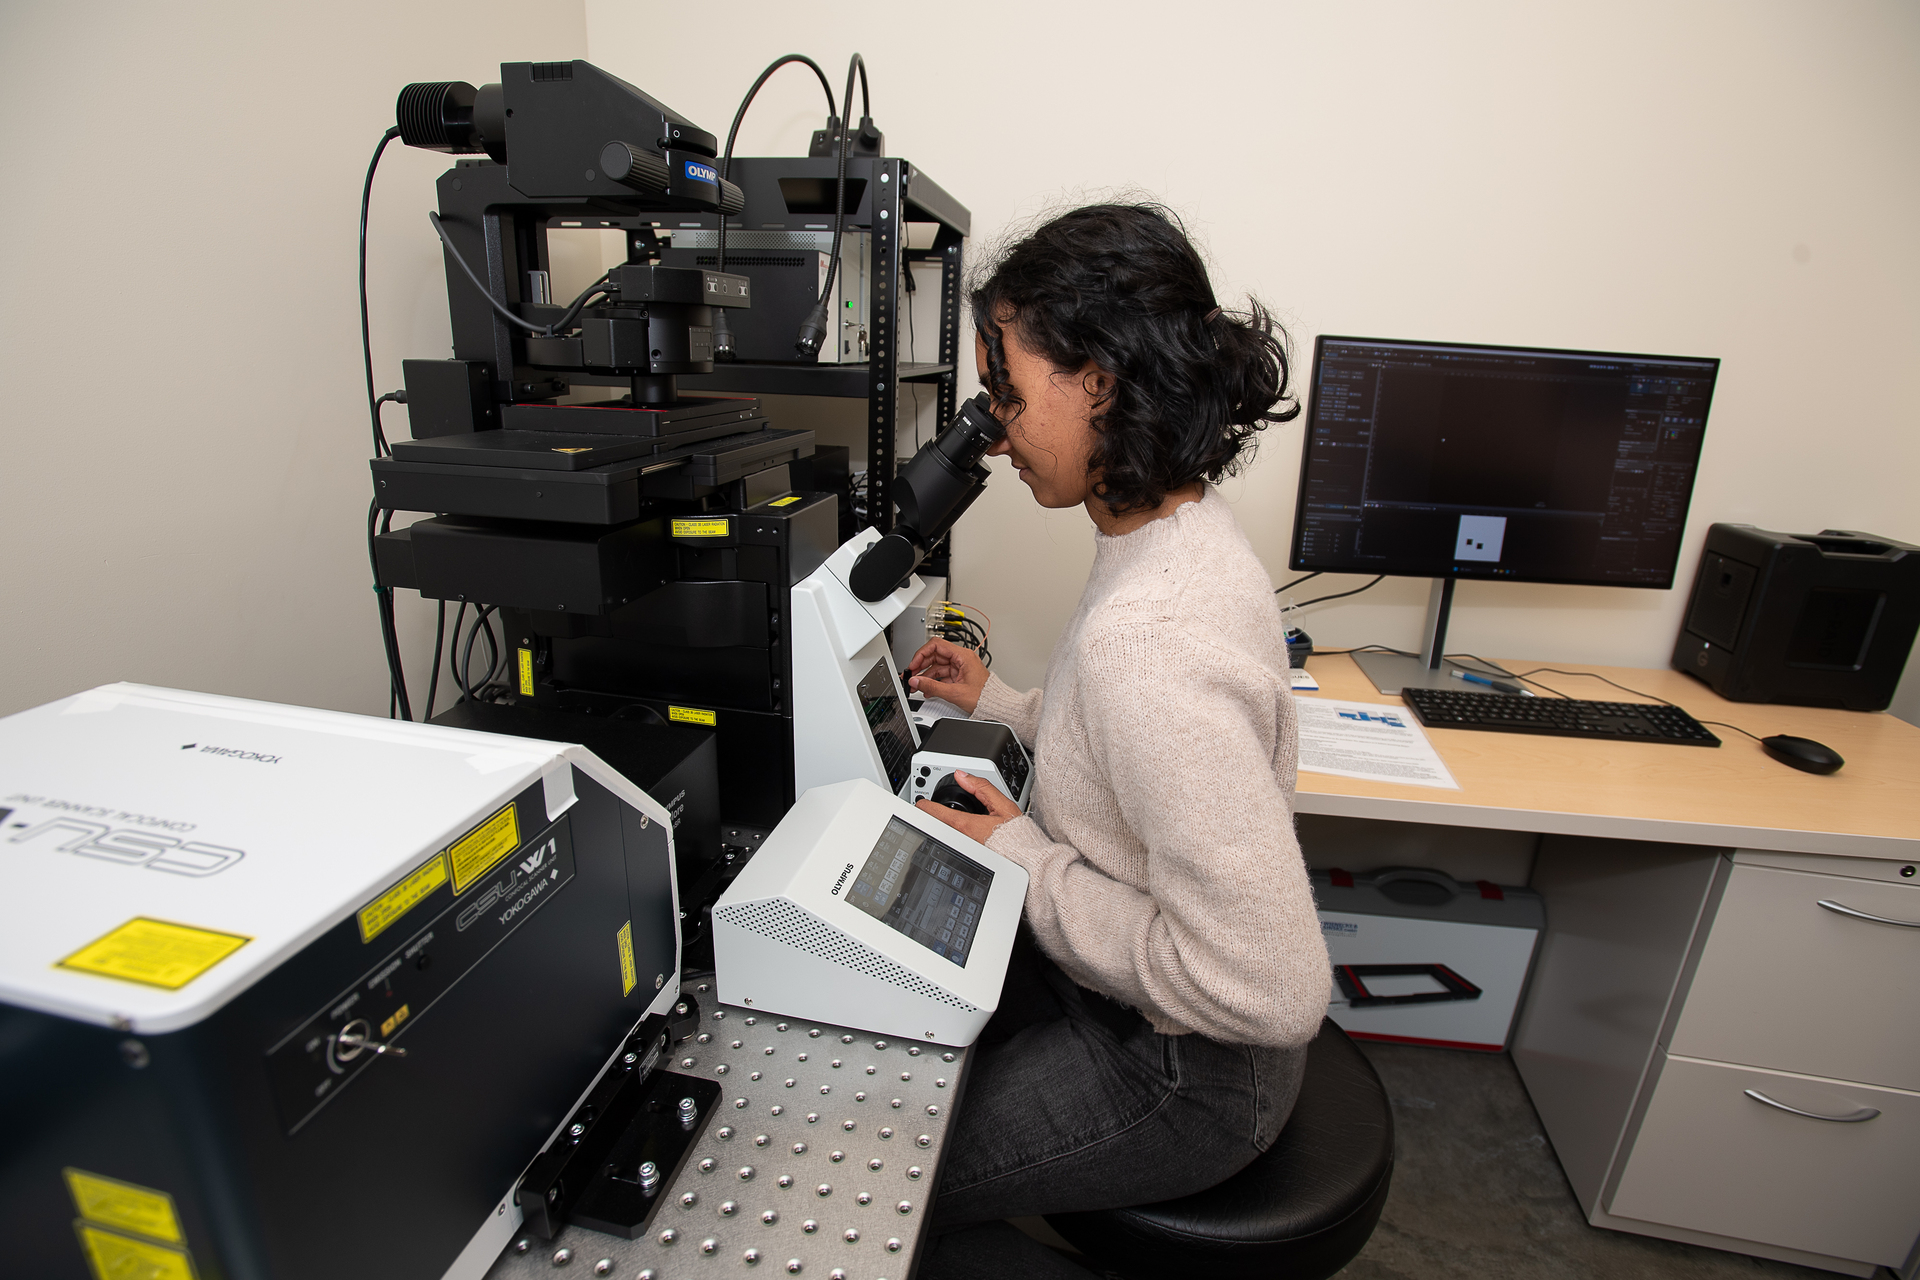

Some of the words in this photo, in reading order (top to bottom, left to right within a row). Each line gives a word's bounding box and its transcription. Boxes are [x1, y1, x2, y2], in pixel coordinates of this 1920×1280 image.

[688, 165, 716, 181] OLYMP
[0, 807, 246, 878] CSU-
[456, 837, 557, 932] CSU-W1
[499, 878, 548, 925] YOKOGAWA
[831, 862, 854, 896] OLYMPUS
